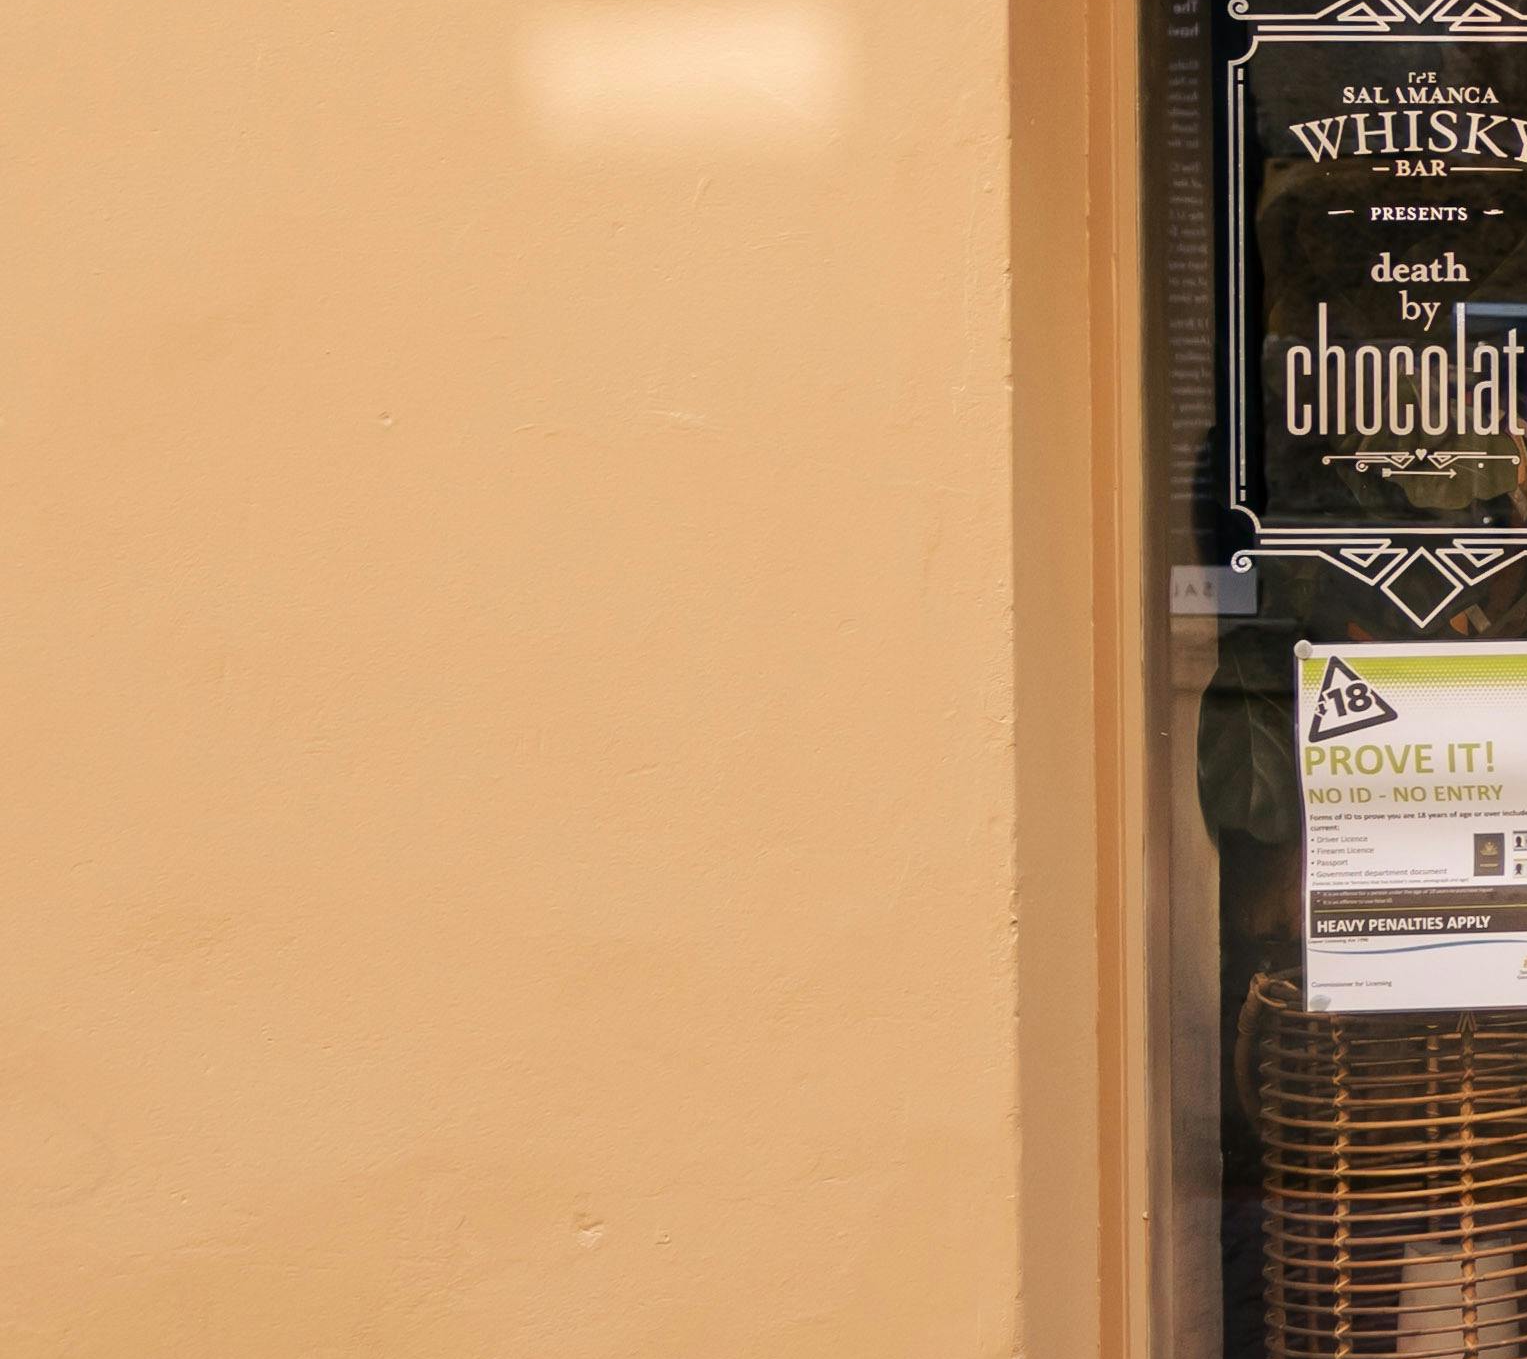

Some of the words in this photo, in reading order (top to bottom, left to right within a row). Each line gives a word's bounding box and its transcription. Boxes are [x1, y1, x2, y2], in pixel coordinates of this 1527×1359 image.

[1396, 160, 1447, 178] BAR
[1370, 206, 1468, 222] PRESENTS
[1370, 253, 1470, 284] death
[1401, 291, 1441, 332] by
[1327, 683, 1372, 717] 18
[1304, 744, 1434, 776] PROVE
[1447, 741, 1495, 773] IT!
[1308, 788, 1343, 805] NO
[1350, 787, 1372, 804] ID
[1392, 786, 1426, 803] NO
[1434, 784, 1503, 802] ENTRY
[1316, 835, 1339, 843] Driver
[1317, 859, 1348, 867] Passport
[1364, 868, 1408, 877] department
[1317, 919, 1365, 933] HEAVY
[1368, 917, 1443, 932] PENALTIES
[1447, 915, 1491, 930] APPLY
